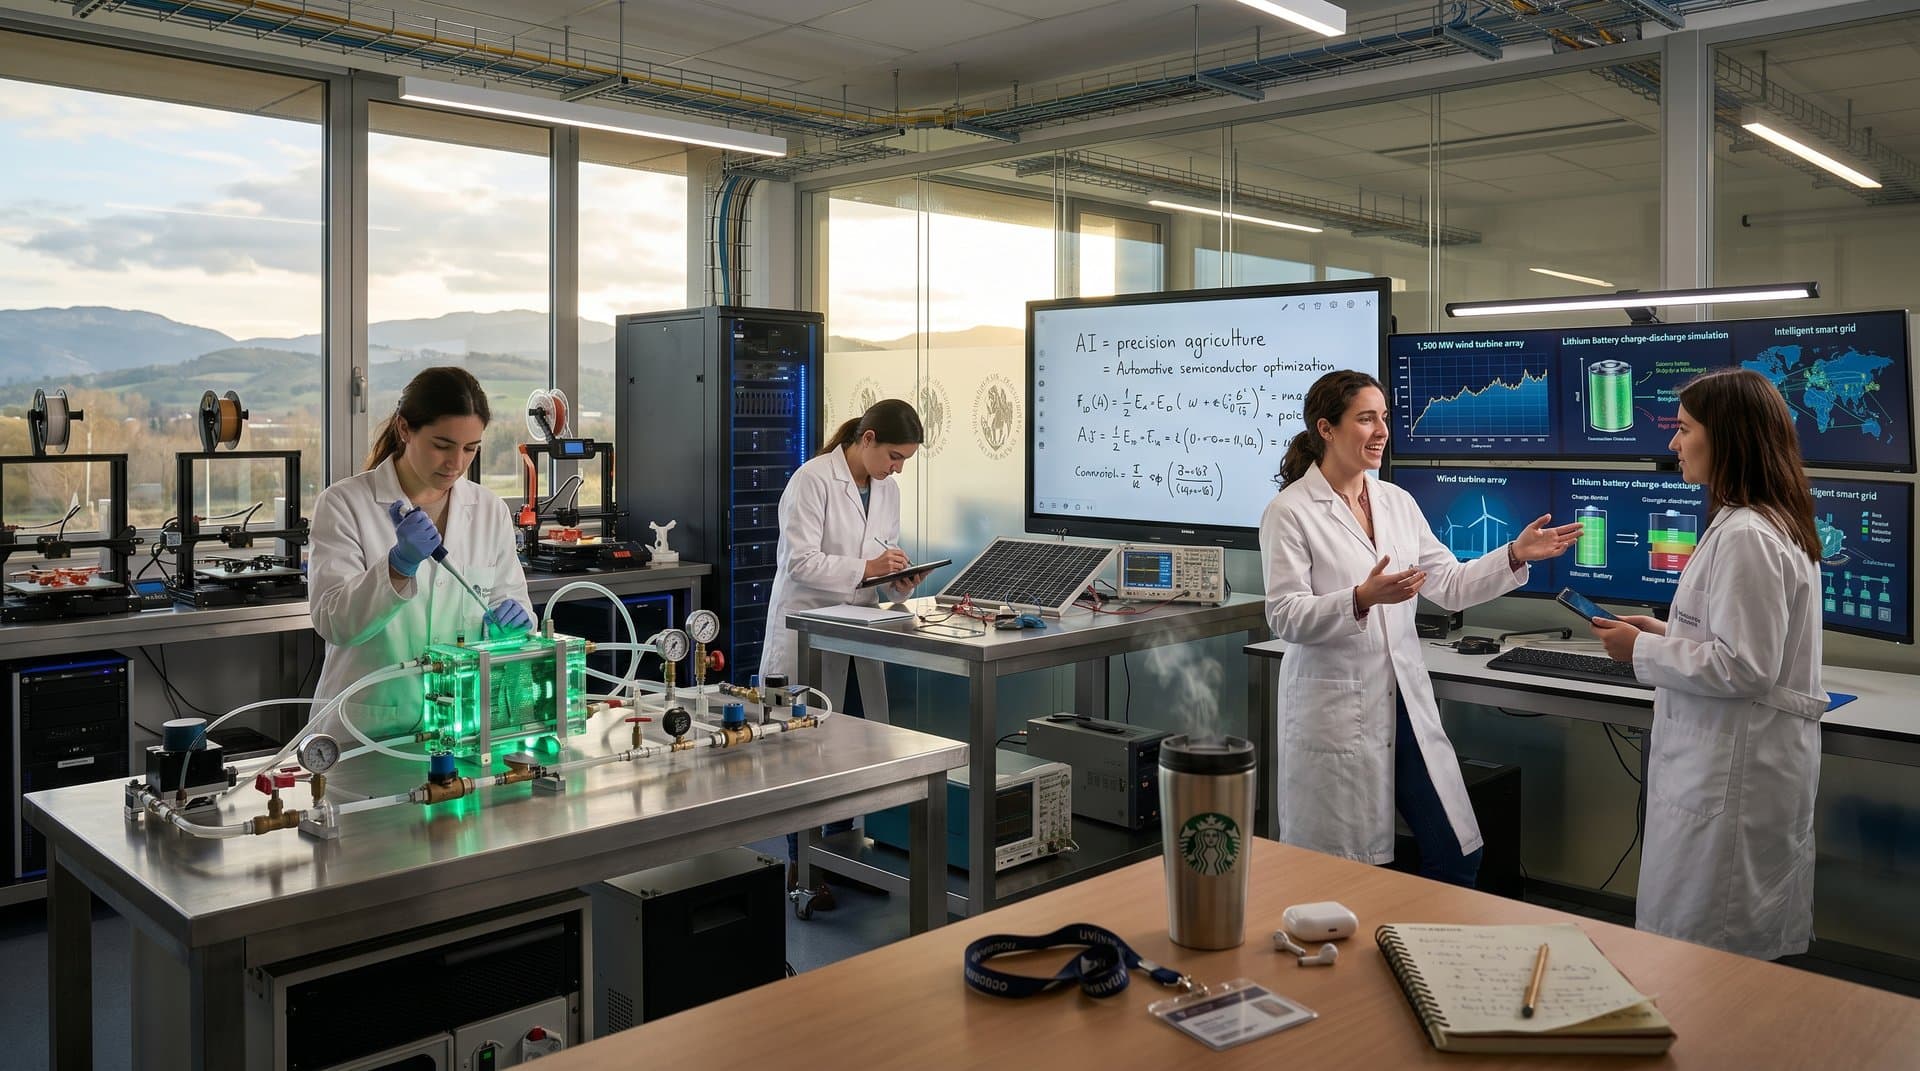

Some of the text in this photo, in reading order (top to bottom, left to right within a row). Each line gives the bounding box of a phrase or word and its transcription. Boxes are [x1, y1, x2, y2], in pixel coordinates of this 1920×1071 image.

[1774, 322, 1856, 337] Intelligent smart grid
[1075, 333, 1097, 353] AI
[1117, 334, 1176, 357] precision
[1185, 327, 1267, 358] agriculture
[1417, 339, 1525, 351] 1,500 MW wind turbine array
[1562, 331, 1729, 346] Lithium Battery charge-discharge simulation
[1116, 360, 1173, 376] Automotive
[1180, 359, 1258, 375] semiconductor
[1263, 357, 1335, 377] optimization
[1436, 474, 1508, 486] Wind turbine array
[1571, 478, 1601, 487] Lithium
[1836, 491, 1859, 499] smart
[1860, 491, 1877, 501] grid
